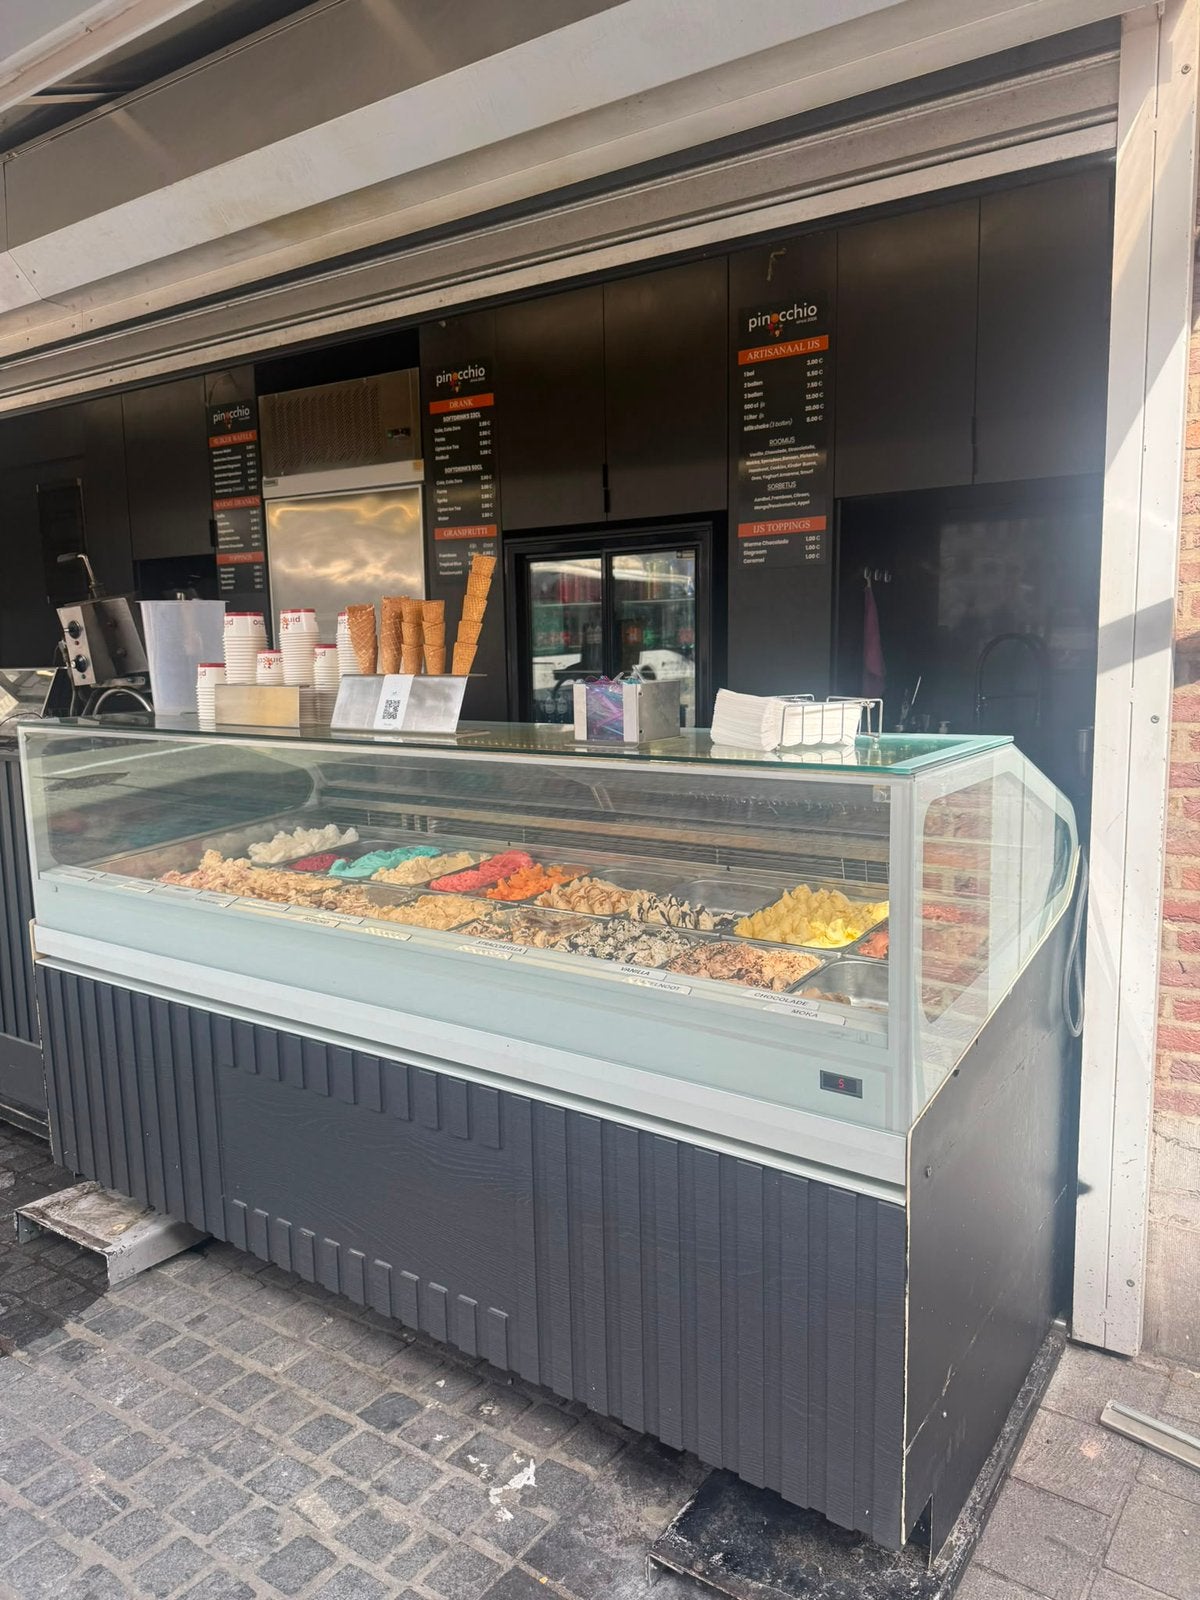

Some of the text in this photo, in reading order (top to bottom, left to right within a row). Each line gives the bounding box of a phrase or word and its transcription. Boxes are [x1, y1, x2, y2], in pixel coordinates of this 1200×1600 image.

[748, 303, 817, 332] pinocchio
[747, 340, 820, 361] ARTISANAAL IJS
[436, 364, 485, 387] pinocchio
[449, 399, 474, 408] DRANK
[213, 405, 250, 424] pinocchio
[444, 527, 488, 537] GRANIFRUTTI
[753, 520, 811, 534] IJS TOPPINGS
[621, 966, 650, 976] VANILLA
[754, 992, 808, 1007] CHOCOLADE
[791, 1009, 818, 1018] MOKA
